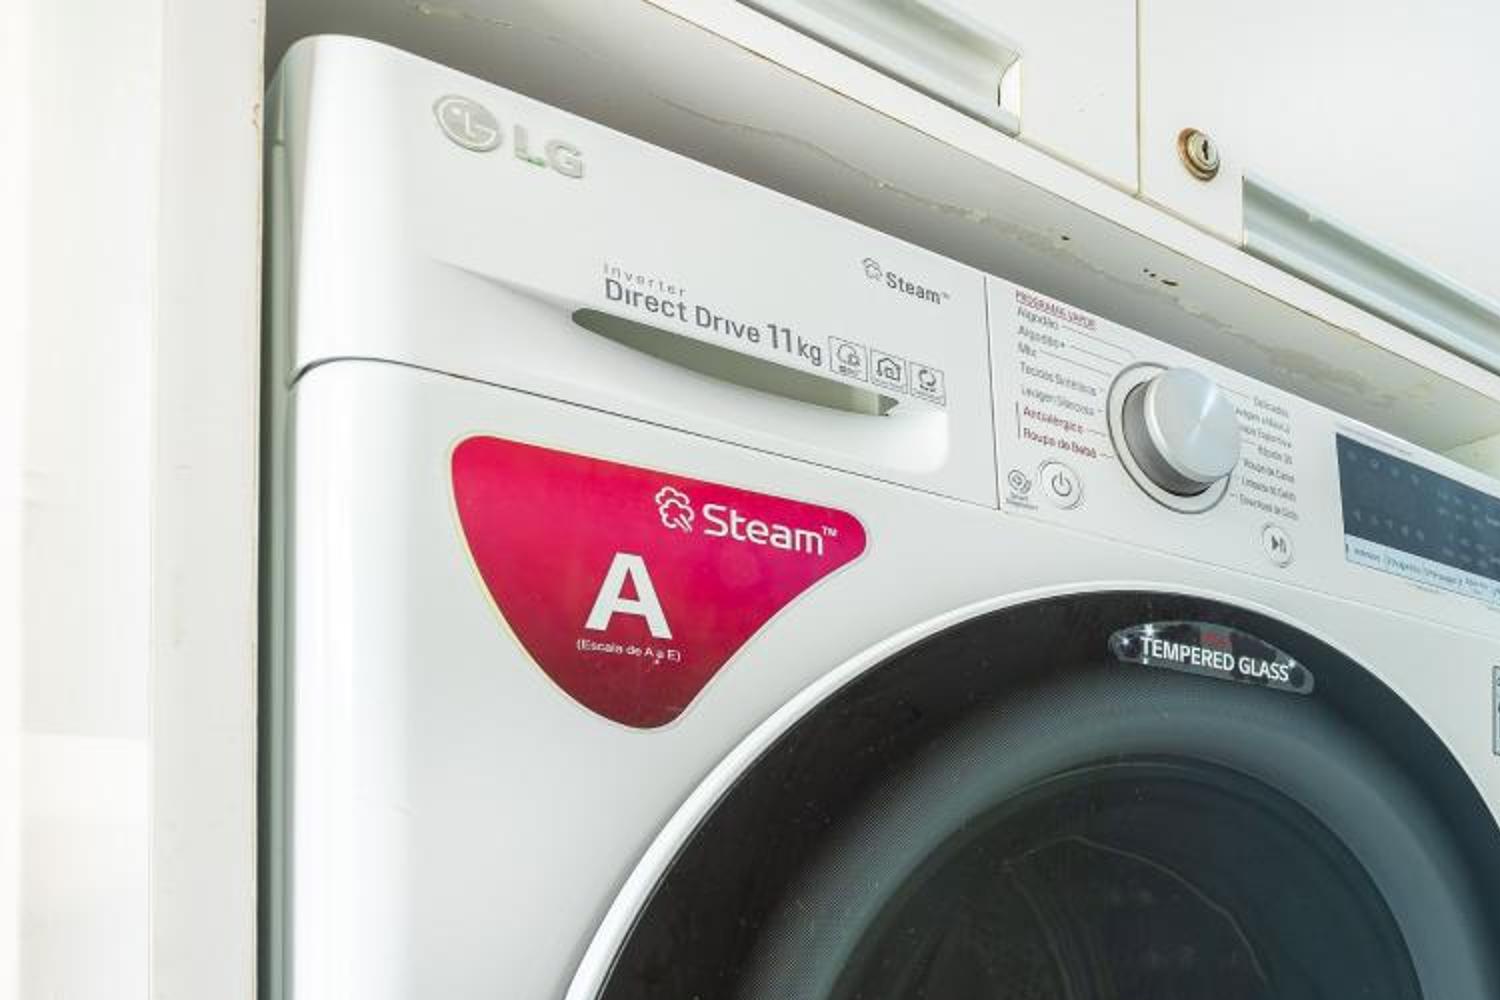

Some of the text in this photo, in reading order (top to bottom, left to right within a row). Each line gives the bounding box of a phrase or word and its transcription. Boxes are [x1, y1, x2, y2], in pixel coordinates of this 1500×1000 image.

[513, 123, 583, 178] LG
[603, 262, 687, 297] Inverter
[605, 277, 689, 323] Direct
[695, 305, 761, 343] Drive
[584, 551, 673, 640] A
[576, 639, 623, 655] (Escala
[626, 645, 642, 657] de
[1140, 635, 1235, 672] TEMPERED
[1238, 655, 1289, 683] GLASS
